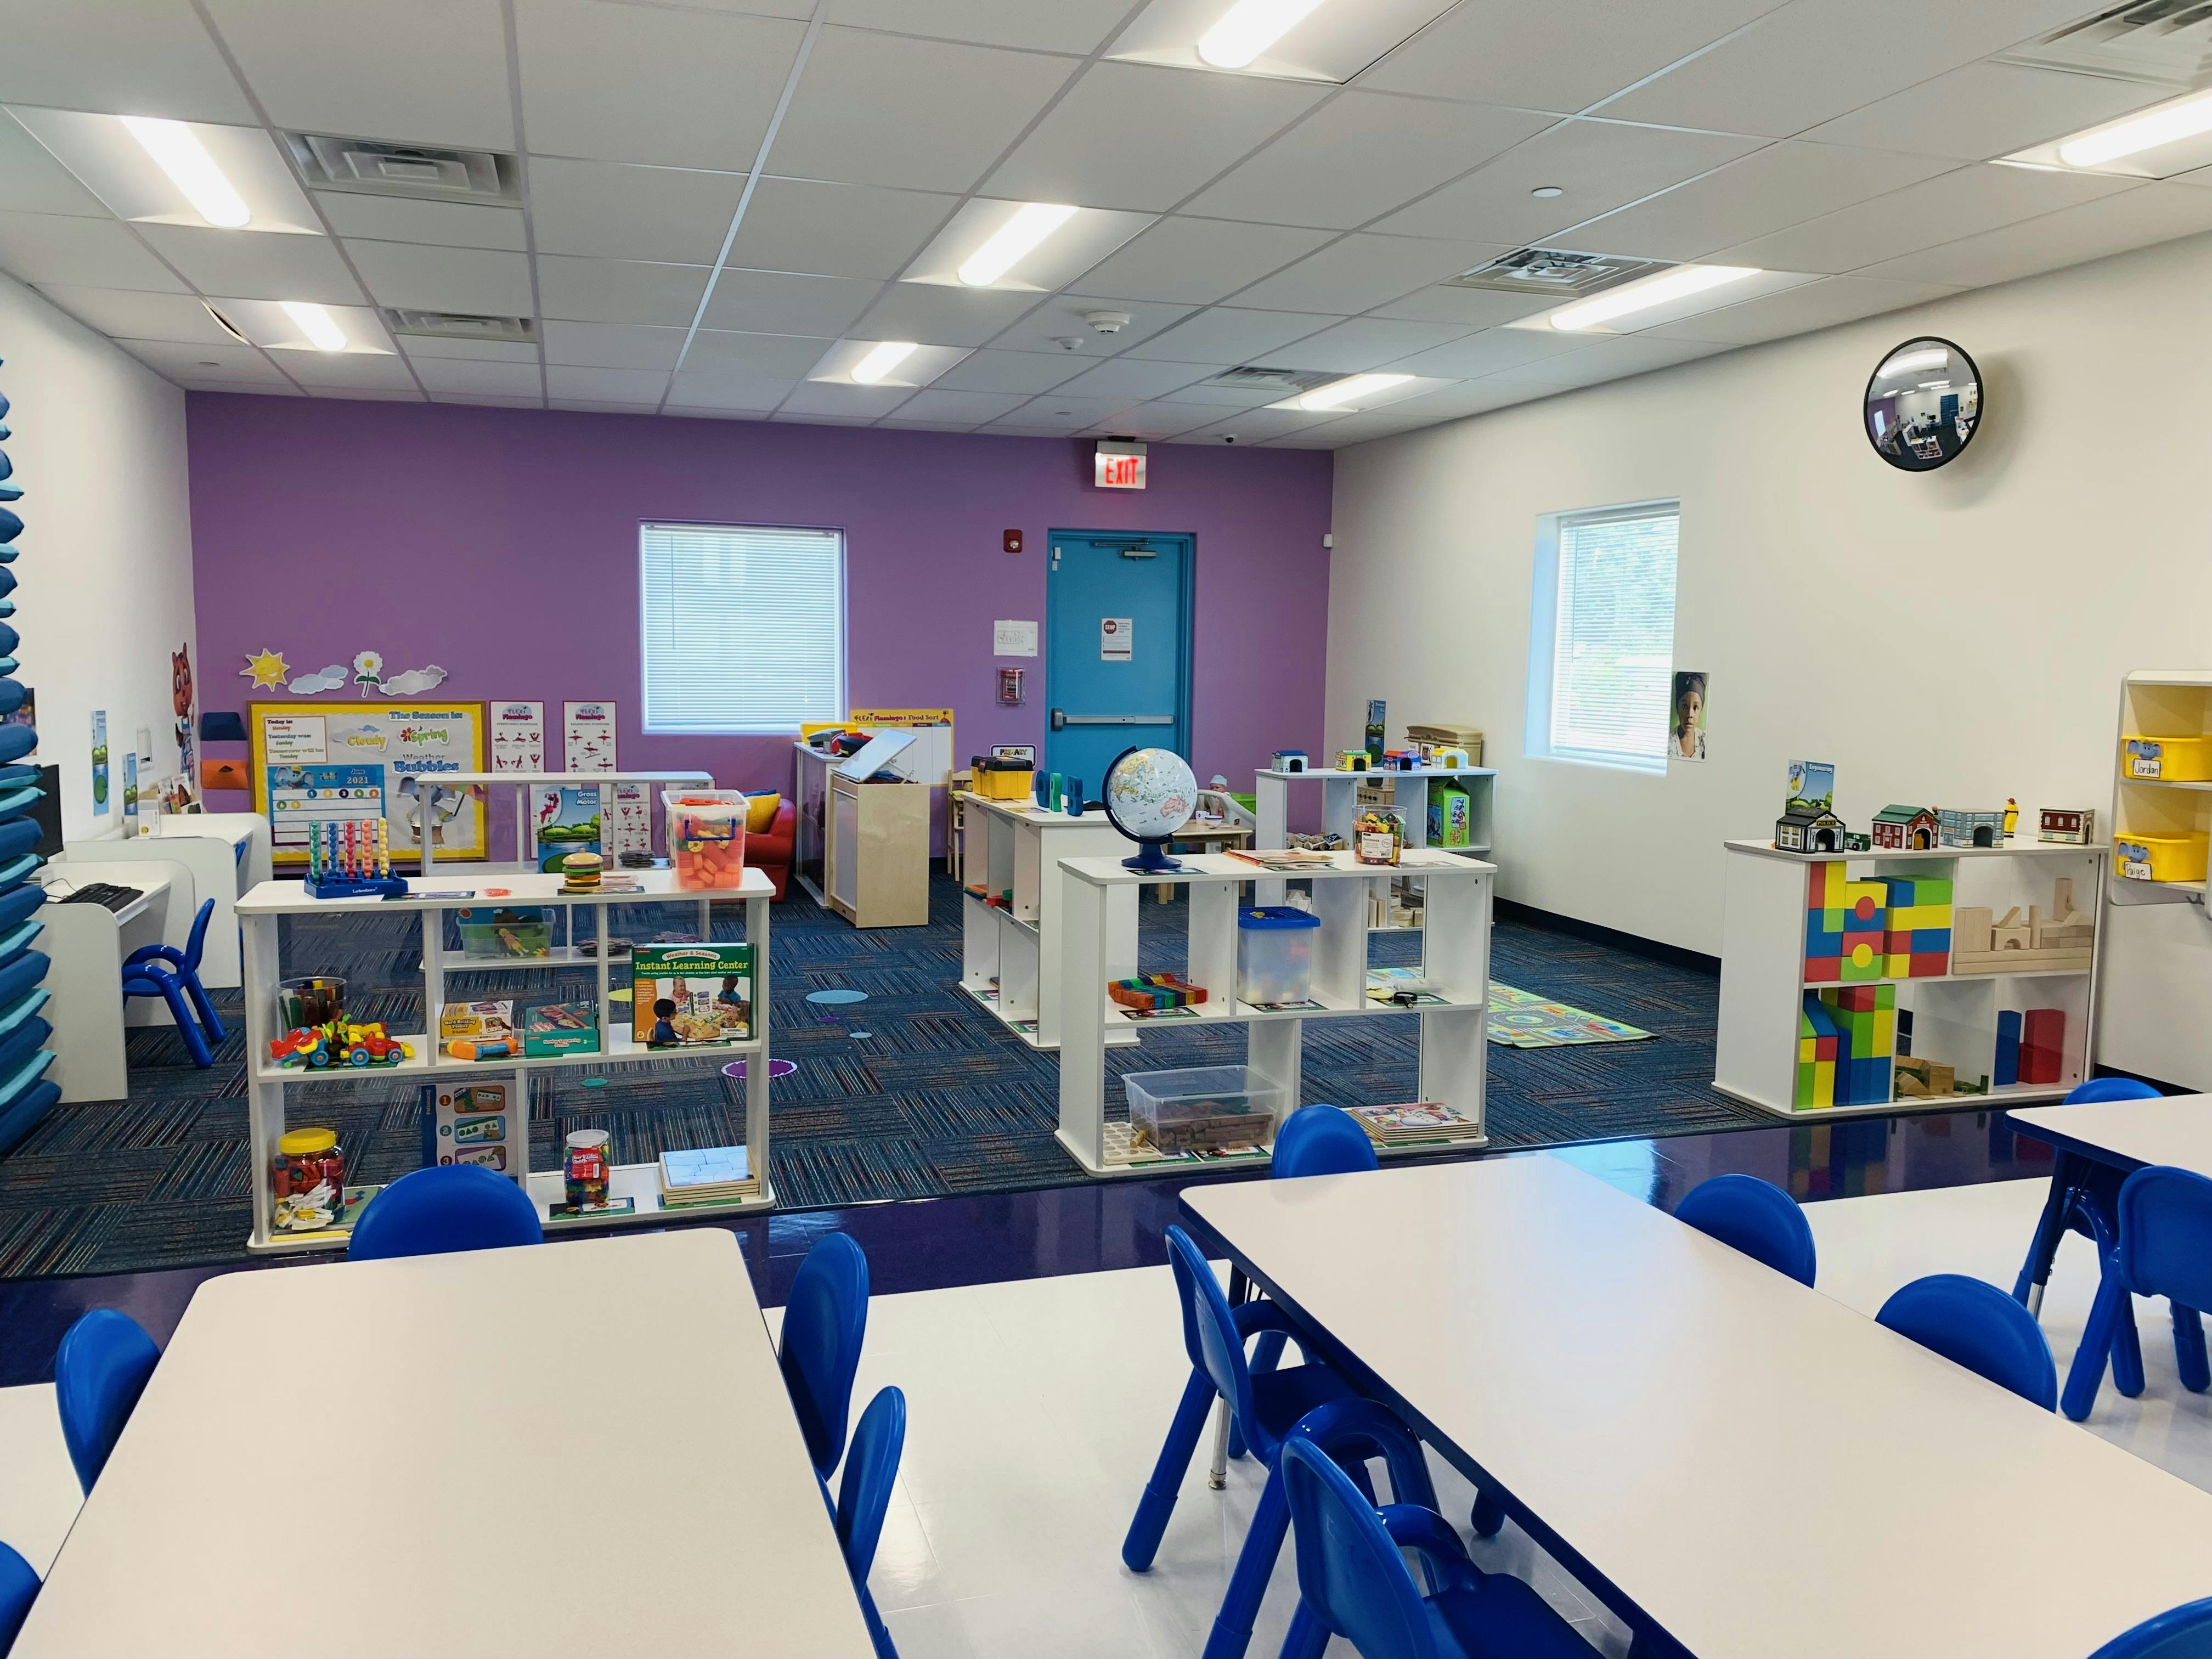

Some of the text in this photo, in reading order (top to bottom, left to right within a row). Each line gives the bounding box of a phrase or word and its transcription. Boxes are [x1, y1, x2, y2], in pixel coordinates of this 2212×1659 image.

[1106, 458, 1138, 485] EXIT
[347, 734, 386, 749] Cloudy
[410, 729, 448, 746] Spring
[393, 760, 459, 772] Bubbles
[2135, 762, 2158, 775] Jordan
[2125, 864, 2146, 878] Paige
[635, 961, 748, 970] Instant Learning Center
[443, 1096, 448, 1104] 1
